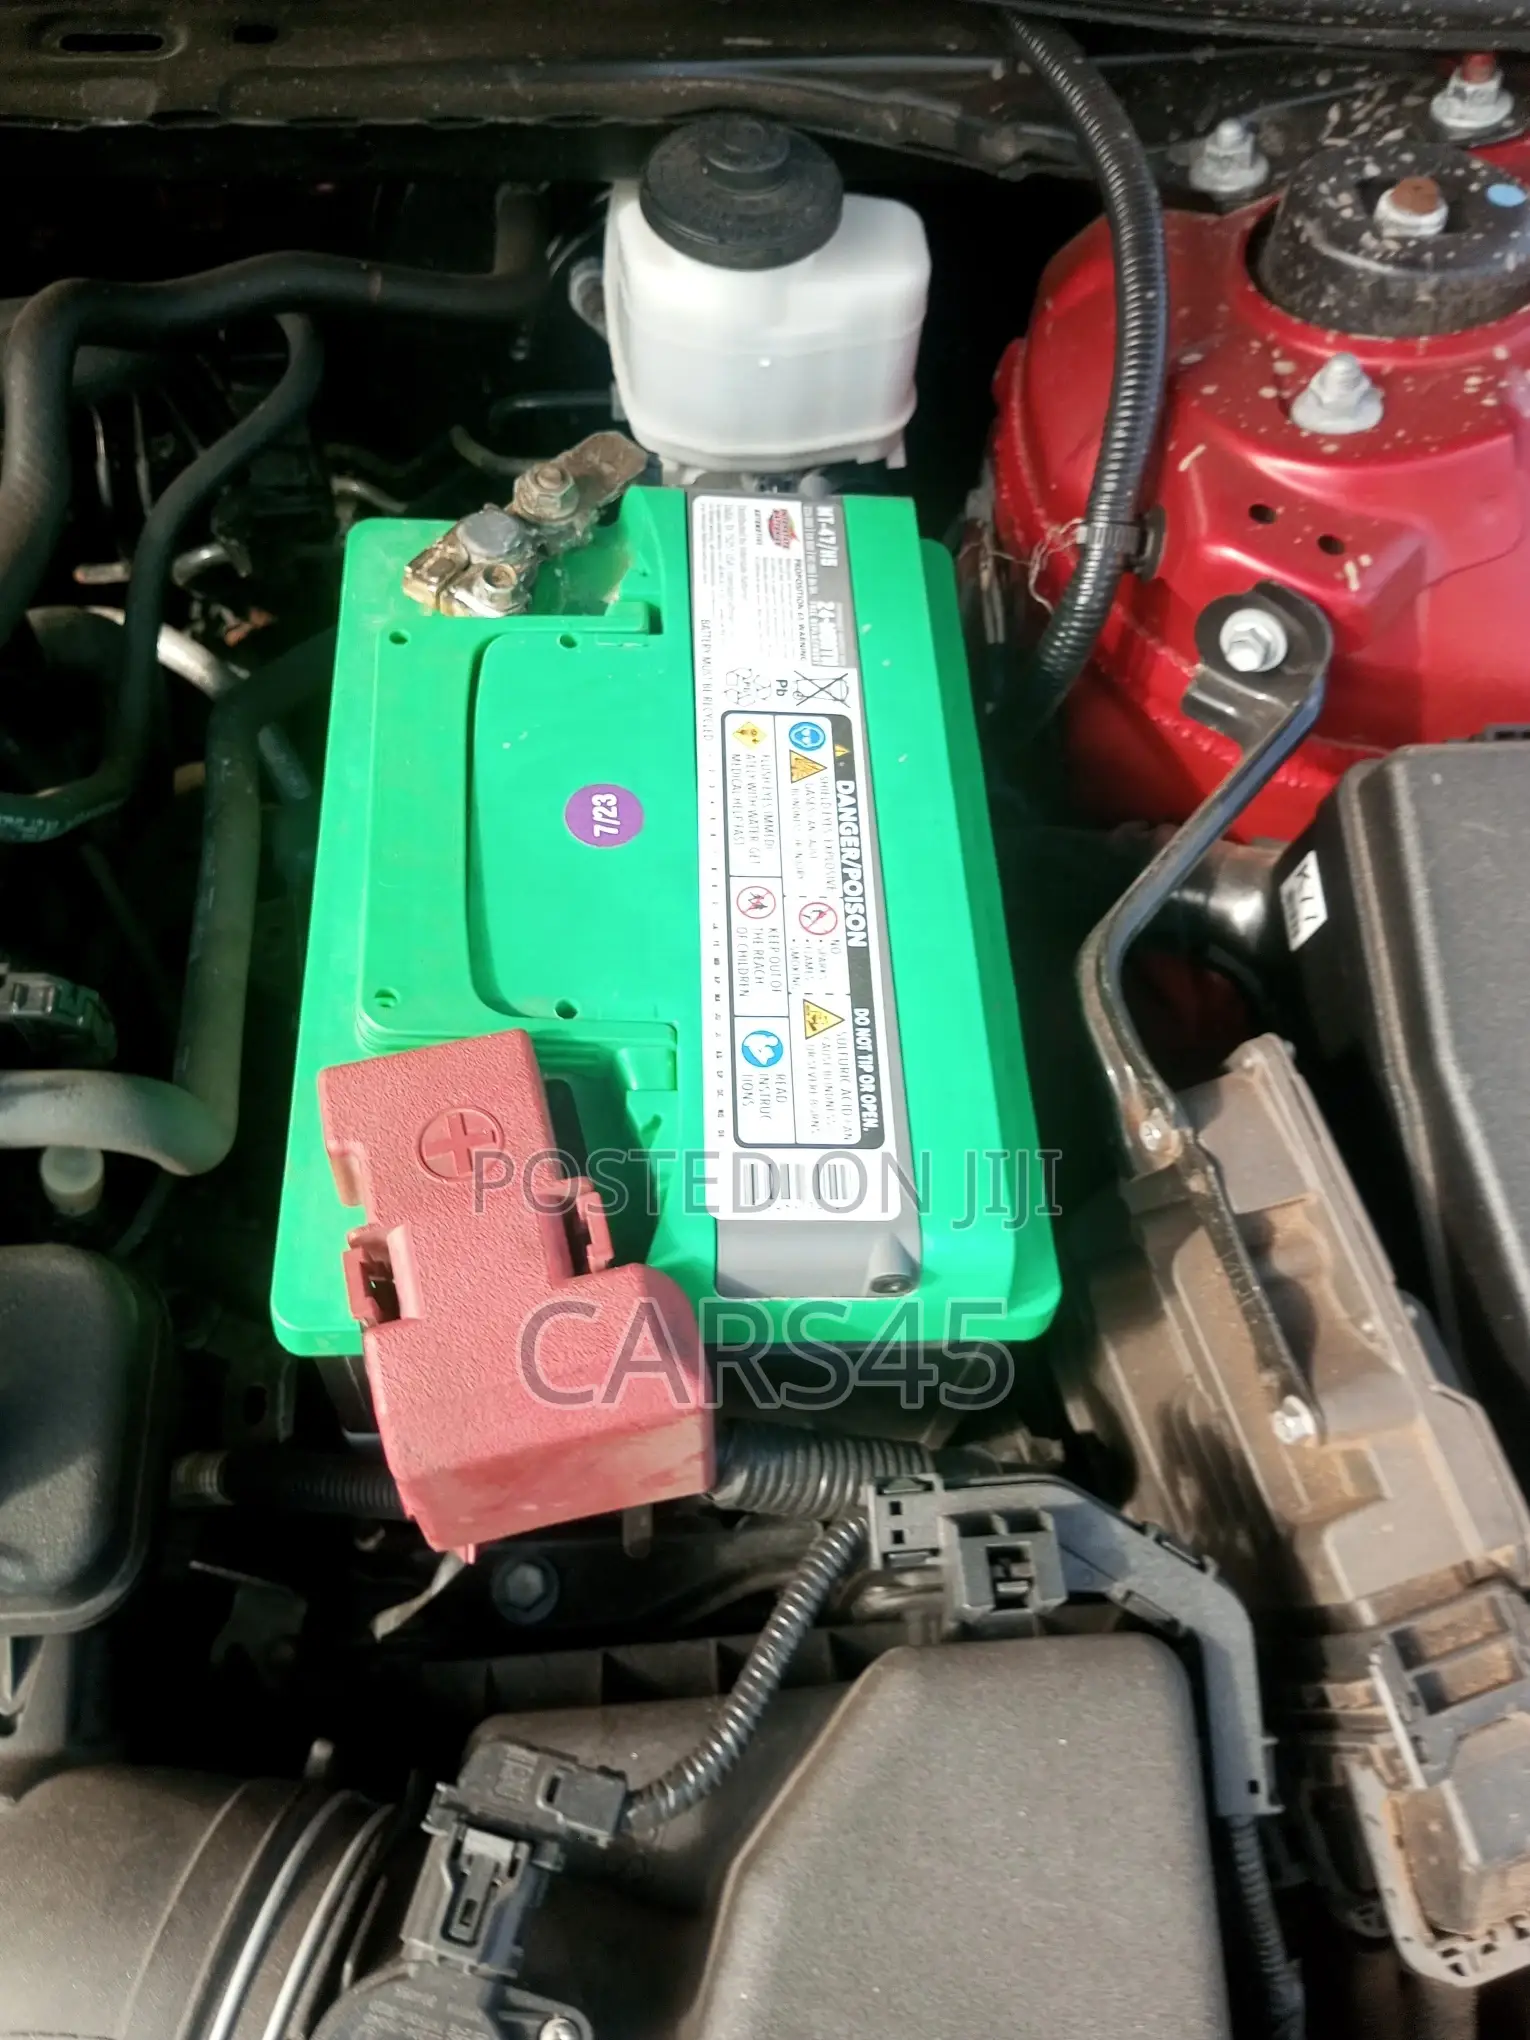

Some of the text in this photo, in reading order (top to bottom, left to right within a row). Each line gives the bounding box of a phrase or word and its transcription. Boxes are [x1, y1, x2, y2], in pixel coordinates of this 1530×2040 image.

[798, 624, 807, 662] WARNING
[776, 679, 788, 697] Pb
[591, 793, 621, 838] 7/23
[836, 781, 867, 947] DANGER/POISON
[830, 939, 841, 955] NO
[737, 943, 752, 997] CHILDREN
[836, 1032, 852, 1084] SULFURIC
[854, 1008, 878, 1131] DO NOT TIP OR OPEN.
[775, 1073, 788, 1103] READ
